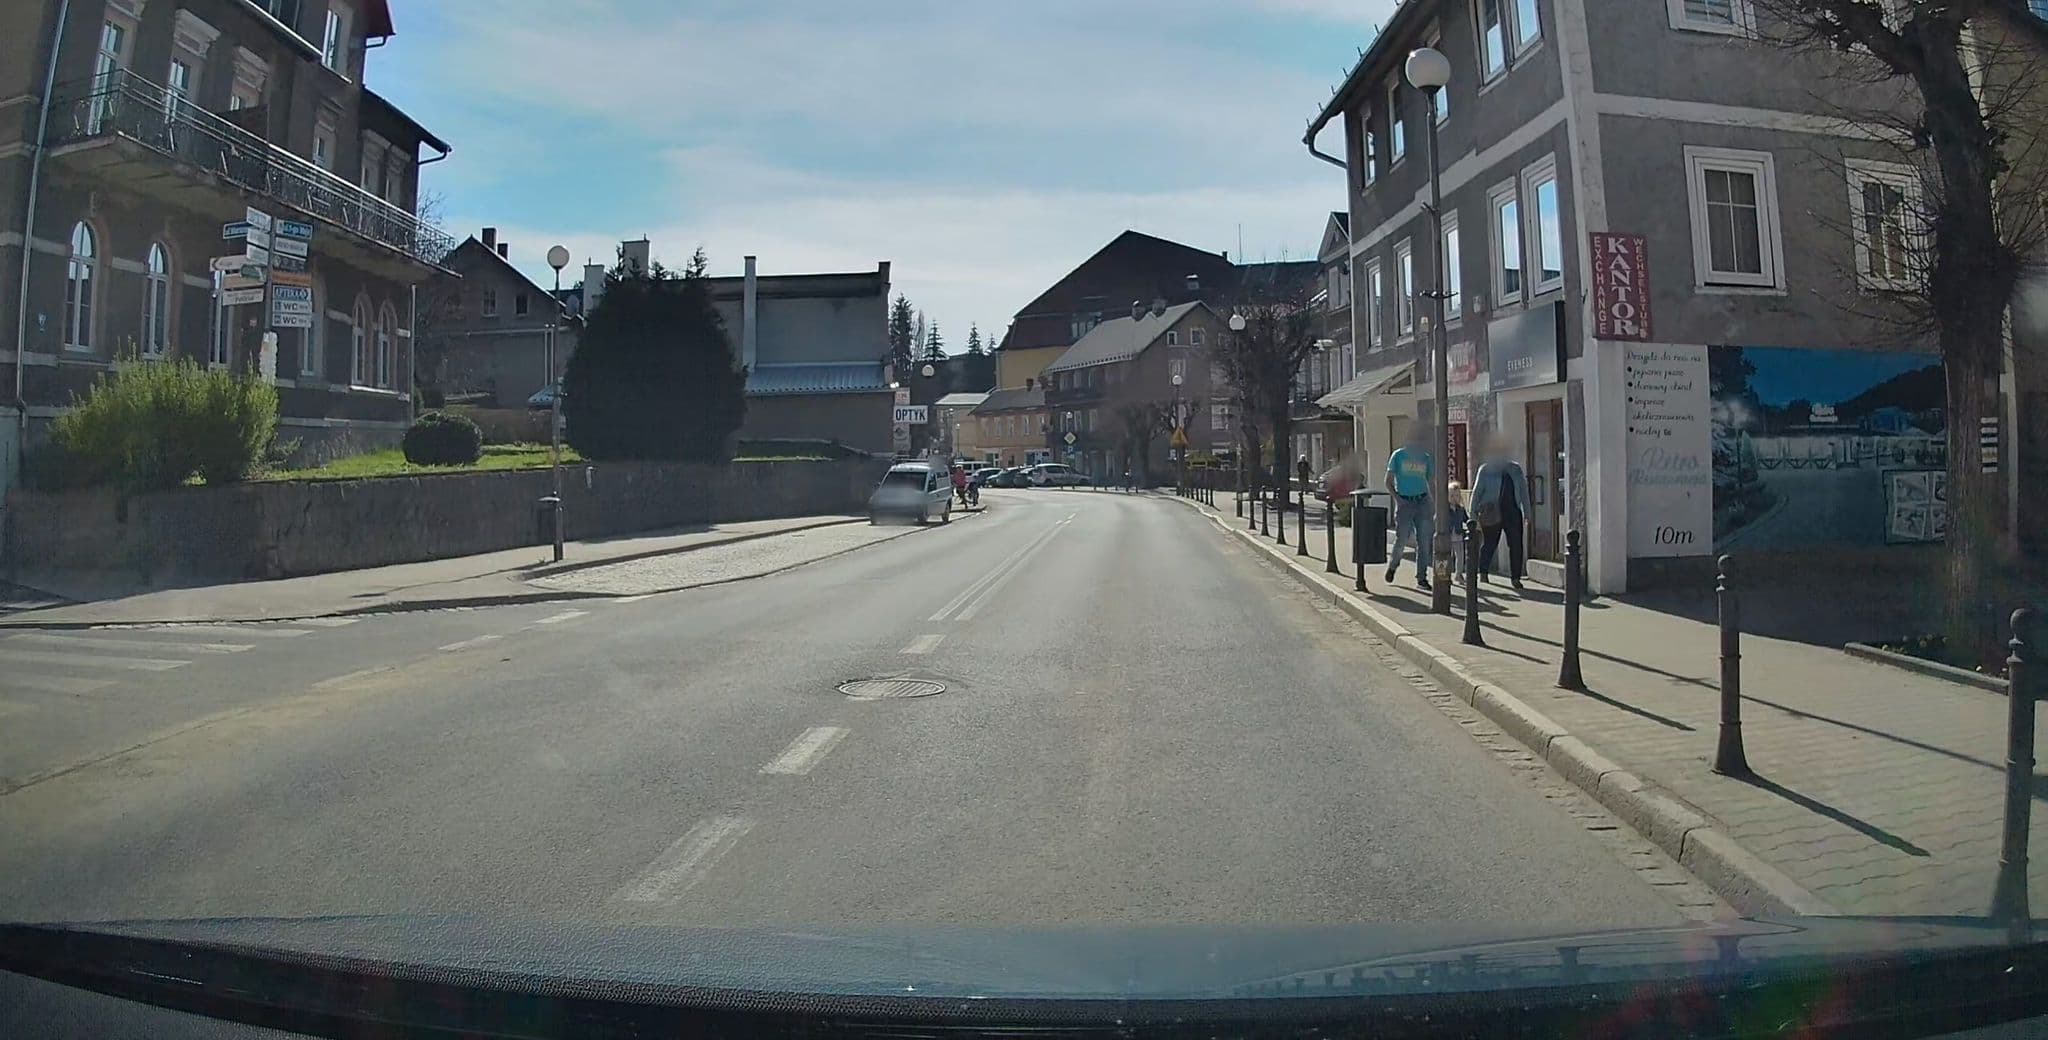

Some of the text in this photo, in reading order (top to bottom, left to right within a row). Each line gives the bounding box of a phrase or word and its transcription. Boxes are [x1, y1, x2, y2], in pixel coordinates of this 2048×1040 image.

[1594, 236, 1607, 334] EXCHANGE
[1608, 237, 1636, 335] KANTOR
[283, 303, 297, 311] WC
[282, 316, 297, 324] WC
[895, 409, 926, 421] OPTYK
[1655, 526, 1695, 544] 10m
